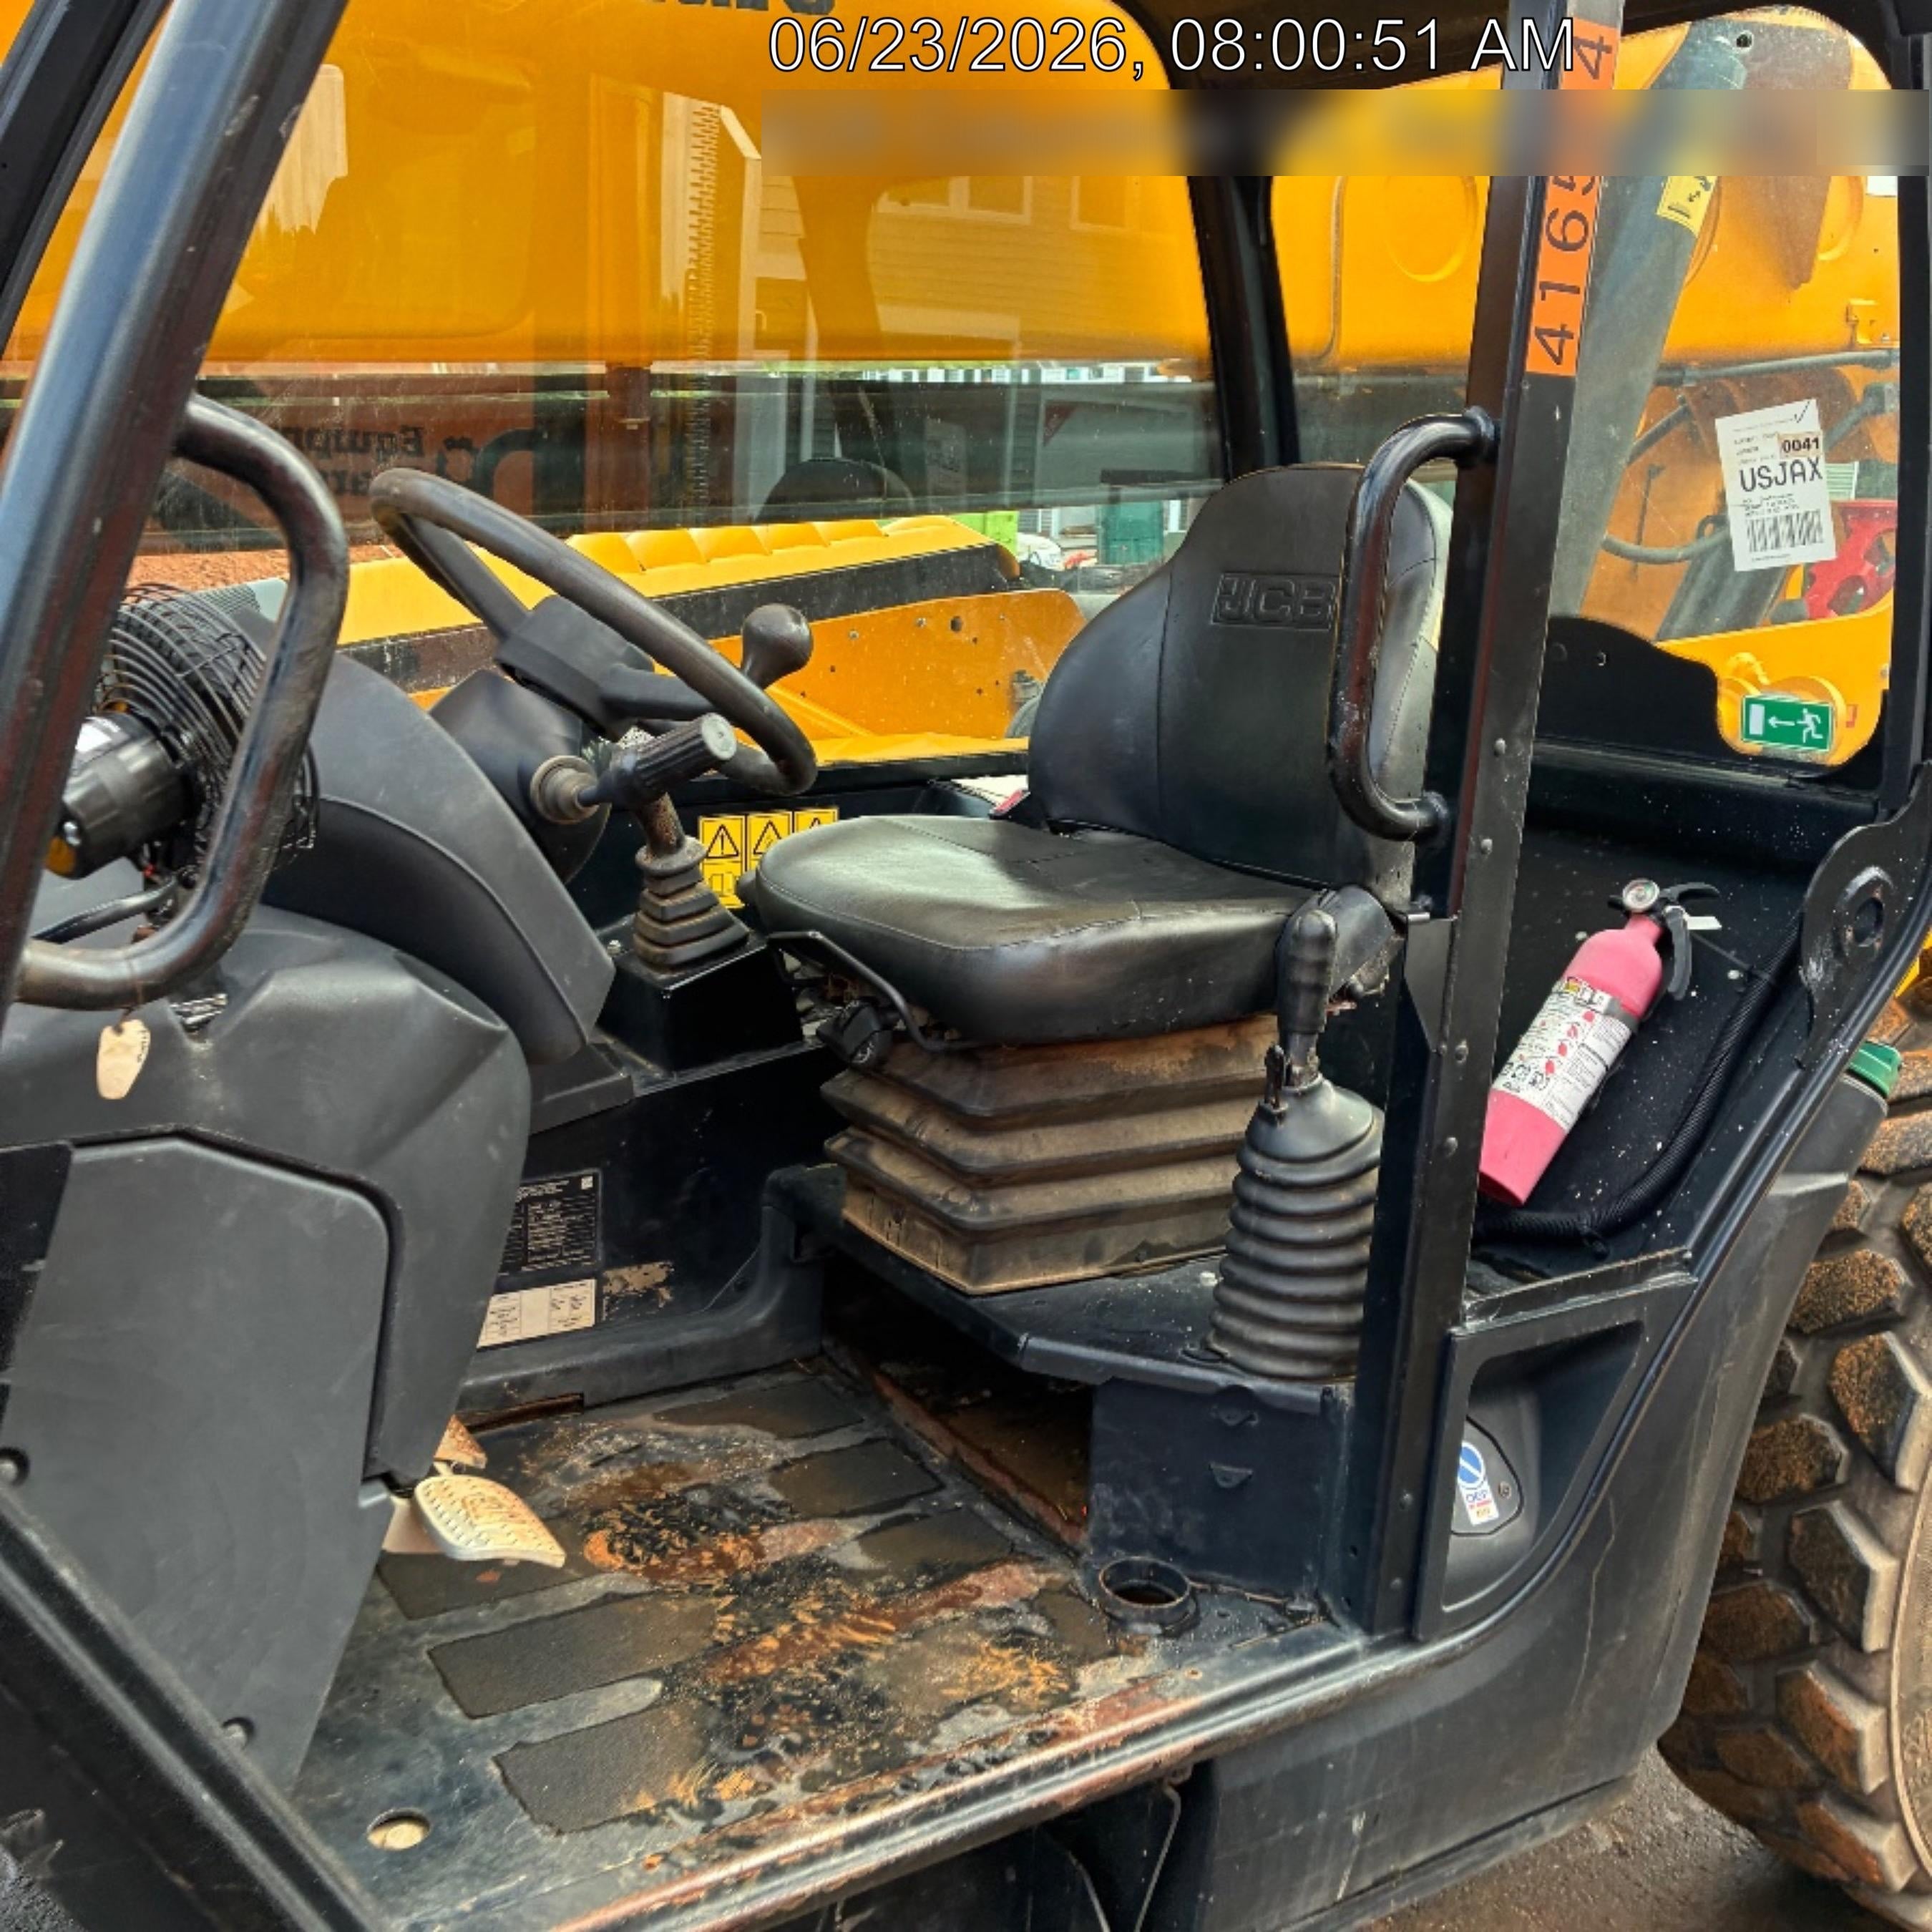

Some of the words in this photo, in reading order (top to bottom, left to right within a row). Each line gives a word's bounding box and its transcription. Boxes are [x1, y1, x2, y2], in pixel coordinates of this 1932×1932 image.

[1782, 436, 1820, 454] 0041
[1740, 457, 1823, 493] USJAX
[1216, 575, 1335, 628] JCB
